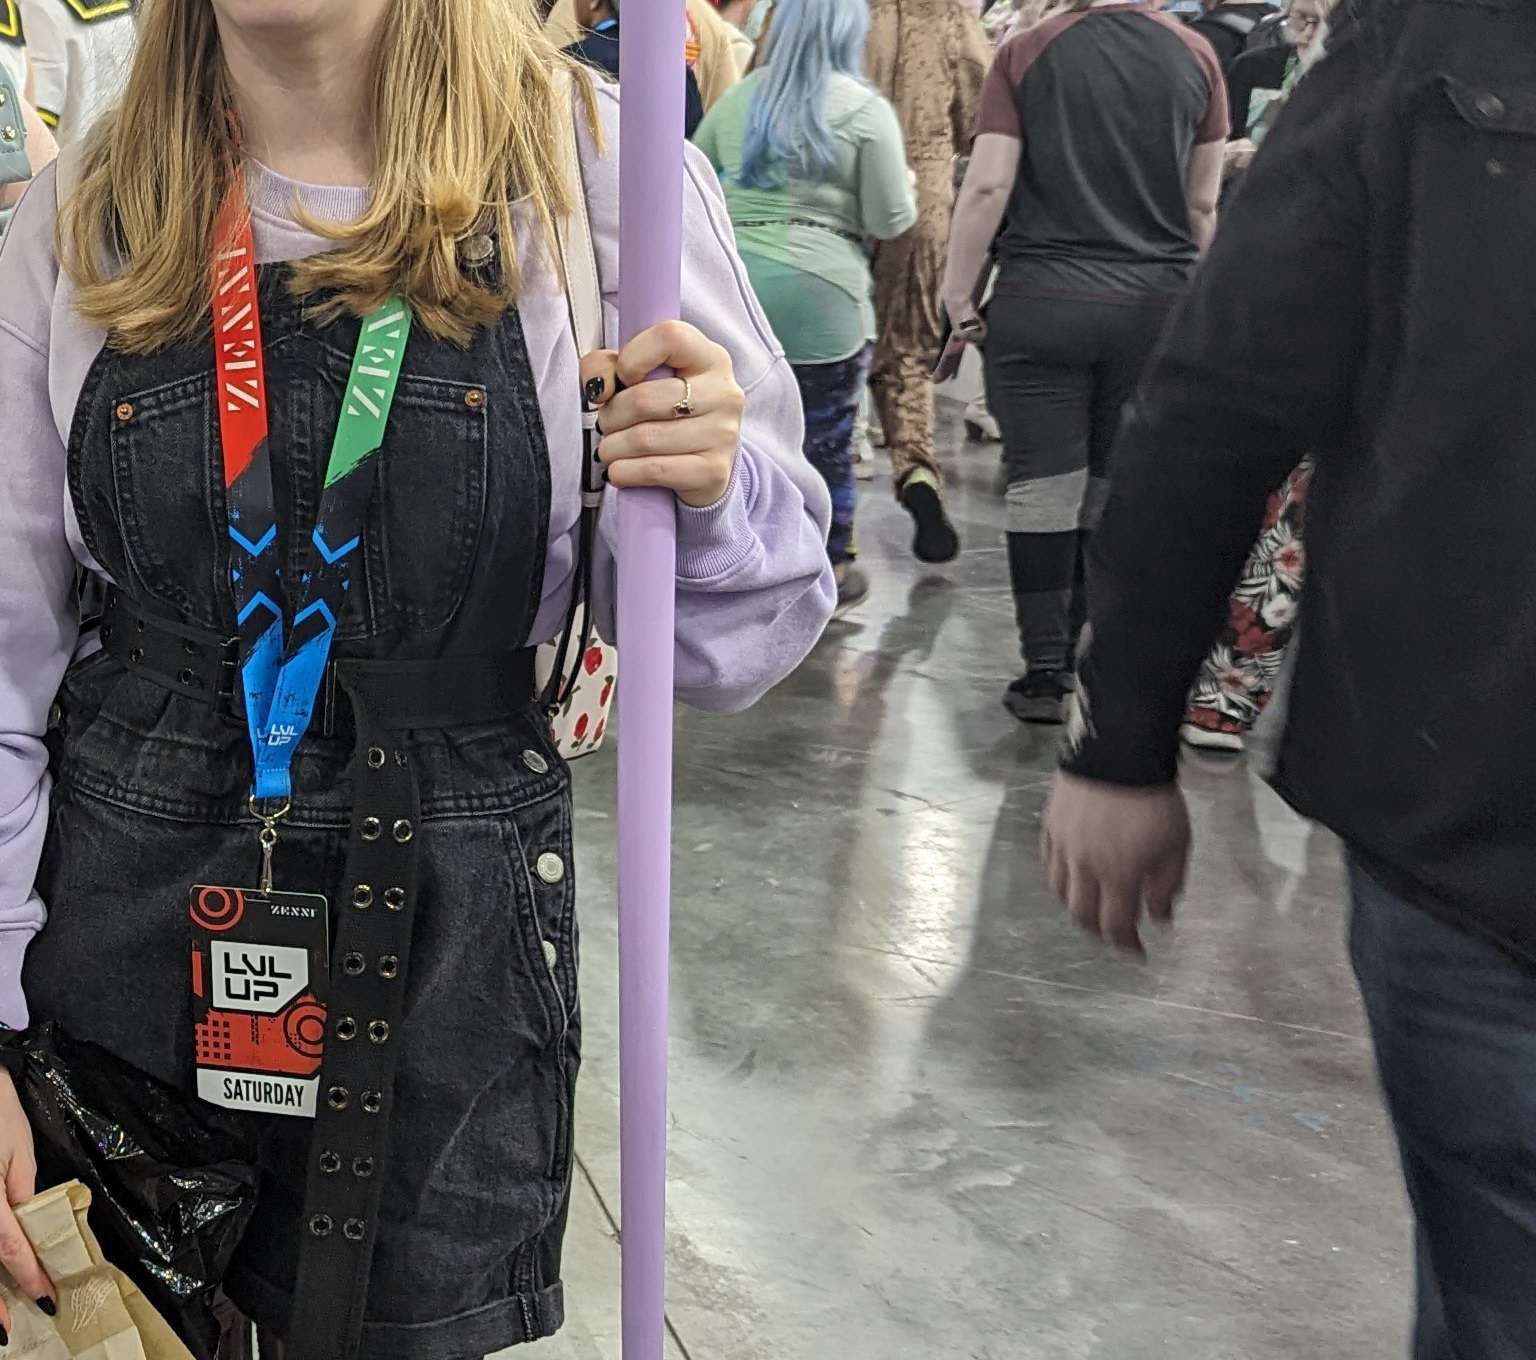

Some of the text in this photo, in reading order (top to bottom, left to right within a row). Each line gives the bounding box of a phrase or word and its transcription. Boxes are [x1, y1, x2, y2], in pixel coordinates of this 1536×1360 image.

[267, 735, 292, 746] UP
[223, 951, 292, 980] LVL
[224, 977, 279, 1001] UP
[223, 1077, 305, 1108] SATURDAY
